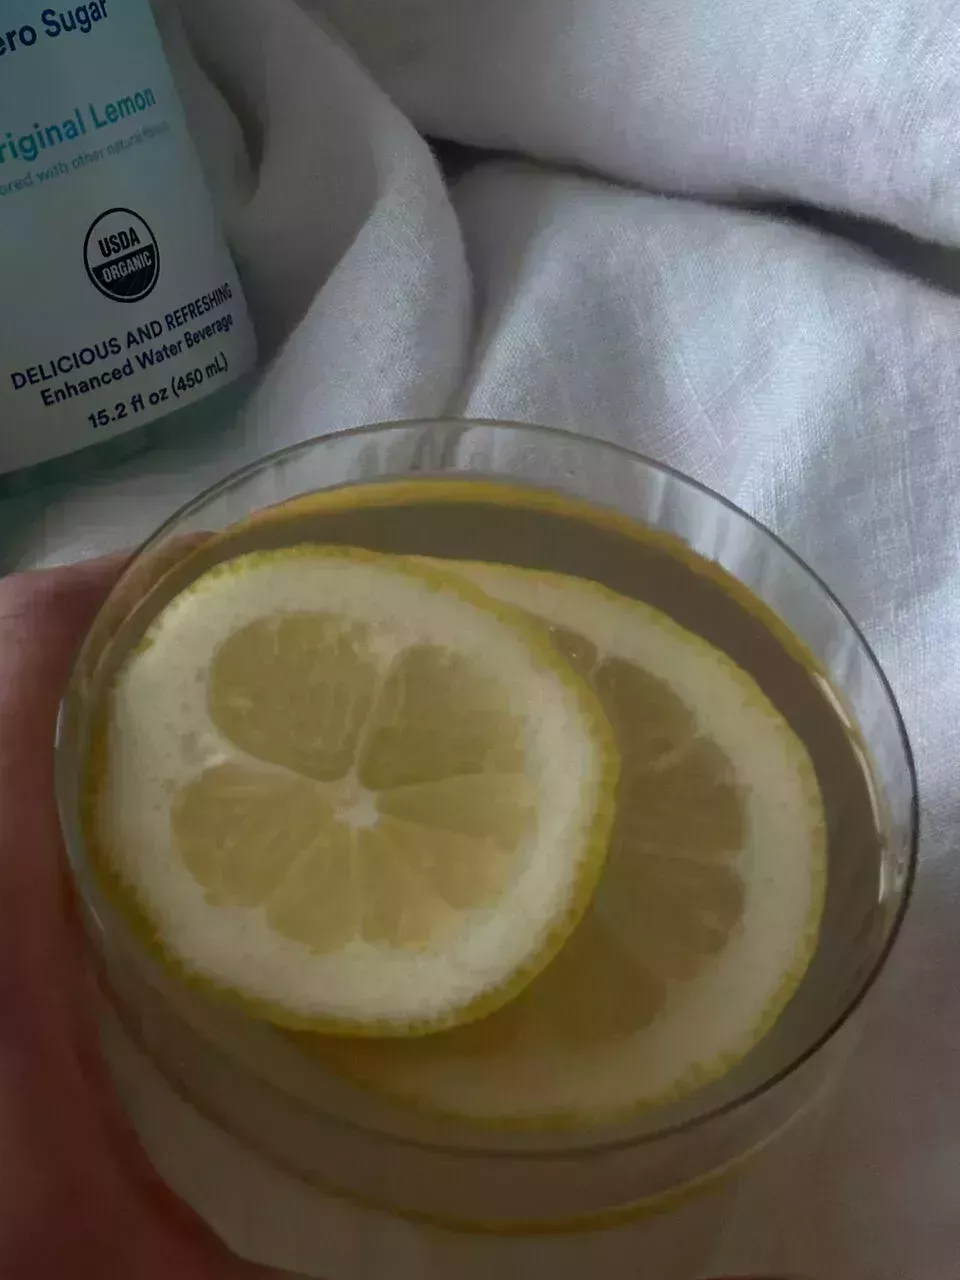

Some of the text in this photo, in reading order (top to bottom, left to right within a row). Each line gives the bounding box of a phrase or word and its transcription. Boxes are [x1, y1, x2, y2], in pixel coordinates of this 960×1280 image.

[89, 87, 157, 130] Lemon
[36, 161, 69, 185] with
[71, 148, 104, 171] other
[98, 226, 140, 258] USDA
[101, 251, 153, 283] ORGANIC
[10, 282, 233, 391] DELICIOUS AND REFRESHING
[40, 312, 234, 407] Enhanced Water Beverage
[88, 350, 229, 429] 15.2 fl oz (450 mL)
